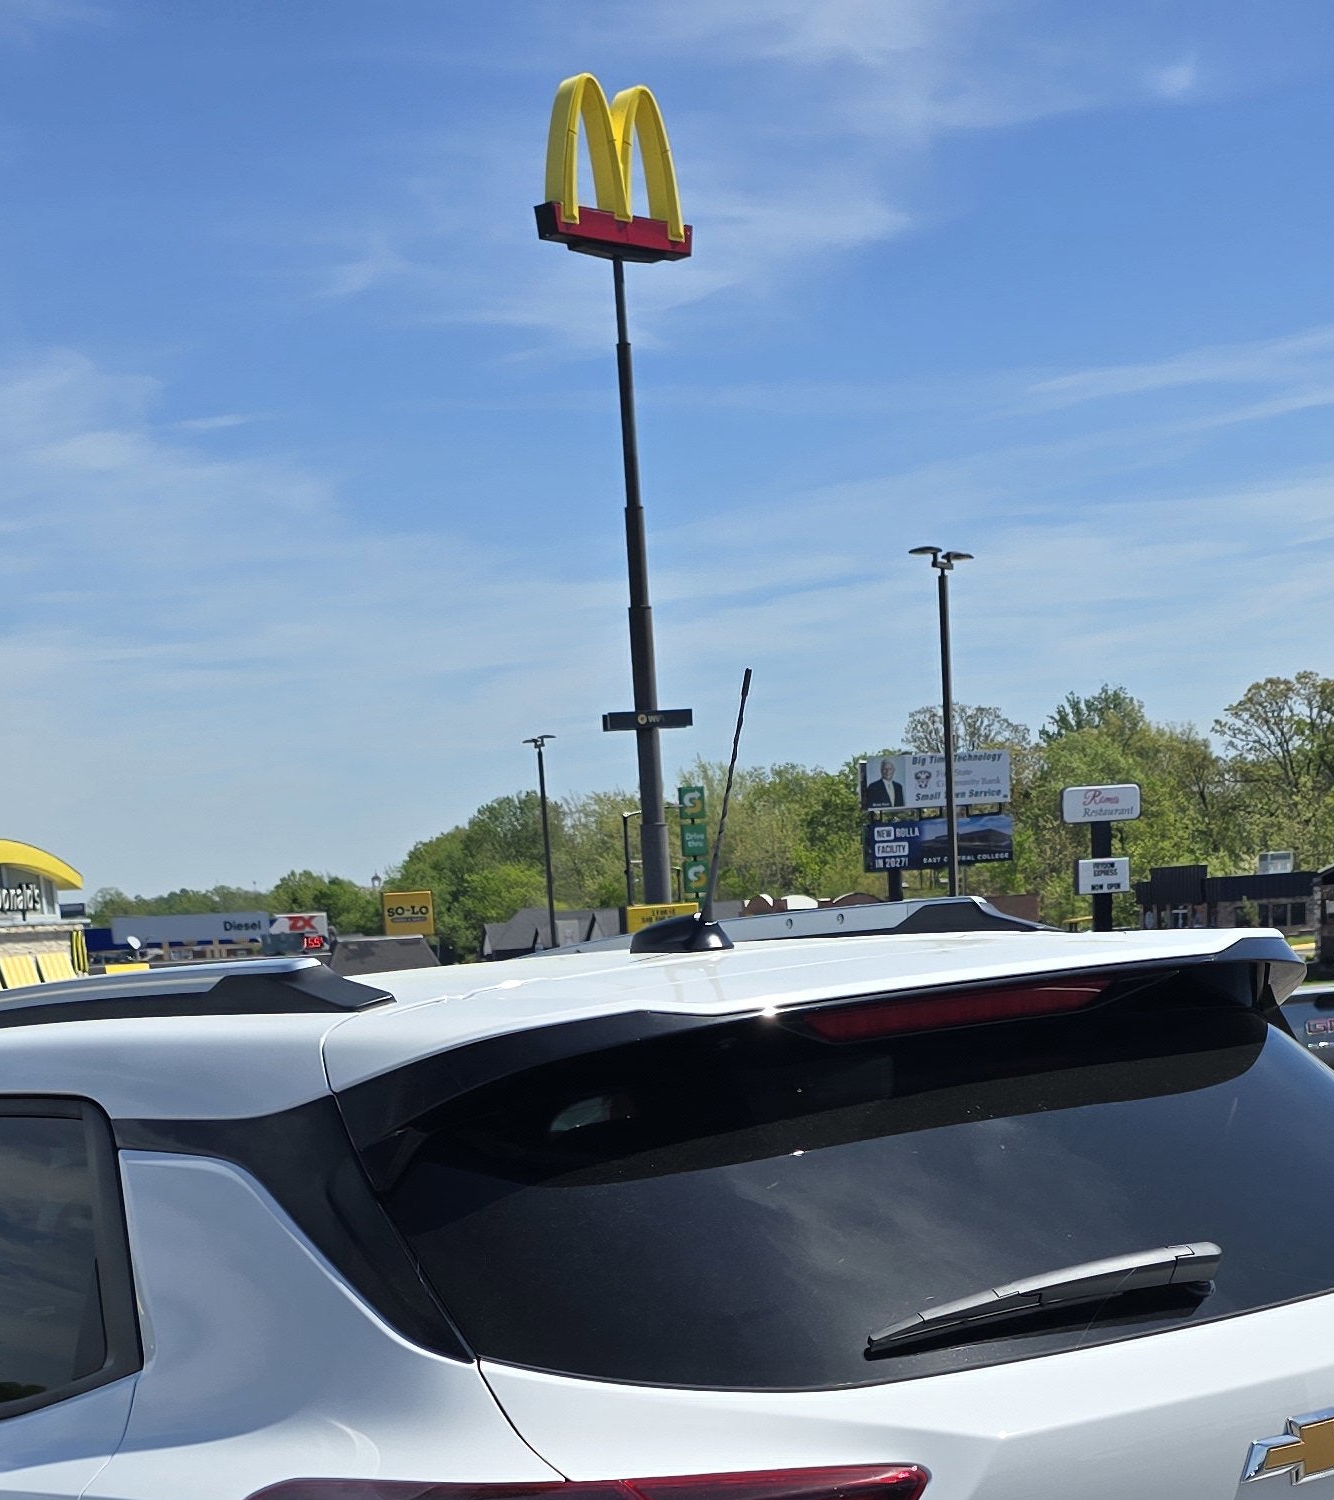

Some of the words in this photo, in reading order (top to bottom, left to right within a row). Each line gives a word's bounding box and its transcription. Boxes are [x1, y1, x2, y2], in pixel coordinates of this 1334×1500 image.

[912, 756, 926, 766] Big
[929, 755, 947, 765] Tim
[953, 752, 1003, 764] Technology
[916, 791, 941, 801] Small
[968, 788, 1002, 798] Service
[1082, 806, 1135, 818] Restaurant
[685, 831, 705, 840] Drive
[876, 829, 893, 839] NEW
[895, 827, 920, 837] ROLLA
[687, 839, 705, 847] thru
[877, 844, 907, 854] FACILITY
[943, 854, 975, 862] CTRAL
[977, 852, 1009, 860] COLLEGE
[875, 859, 884, 868] IN
[387, 905, 429, 917] SO-LO
[223, 920, 261, 932] Diesel
